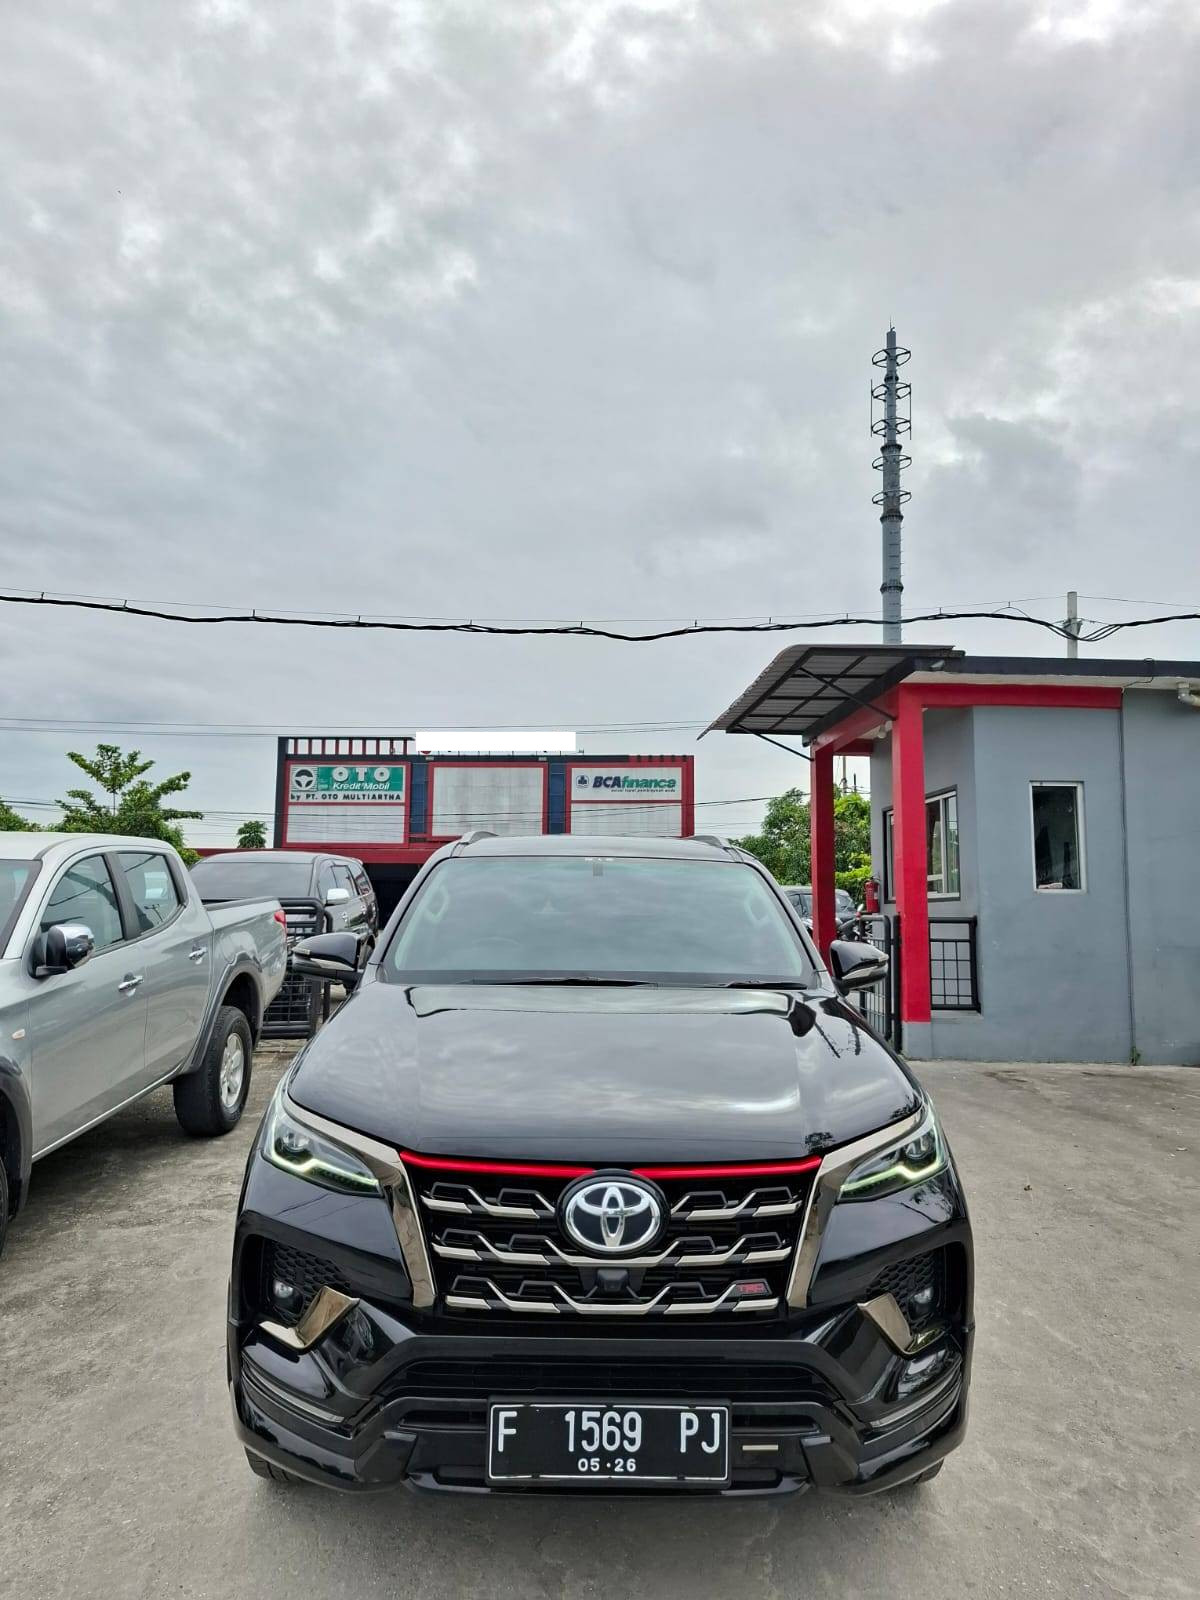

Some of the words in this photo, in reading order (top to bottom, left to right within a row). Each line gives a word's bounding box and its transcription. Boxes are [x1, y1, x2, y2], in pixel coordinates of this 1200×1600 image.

[332, 766, 390, 782] OTO
[333, 782, 361, 791] Kredit
[363, 782, 391, 791] Mobil
[290, 793, 301, 801] by
[497, 1410, 518, 1453] F
[564, 1410, 643, 1453] 1569
[680, 1411, 721, 1454] PJ
